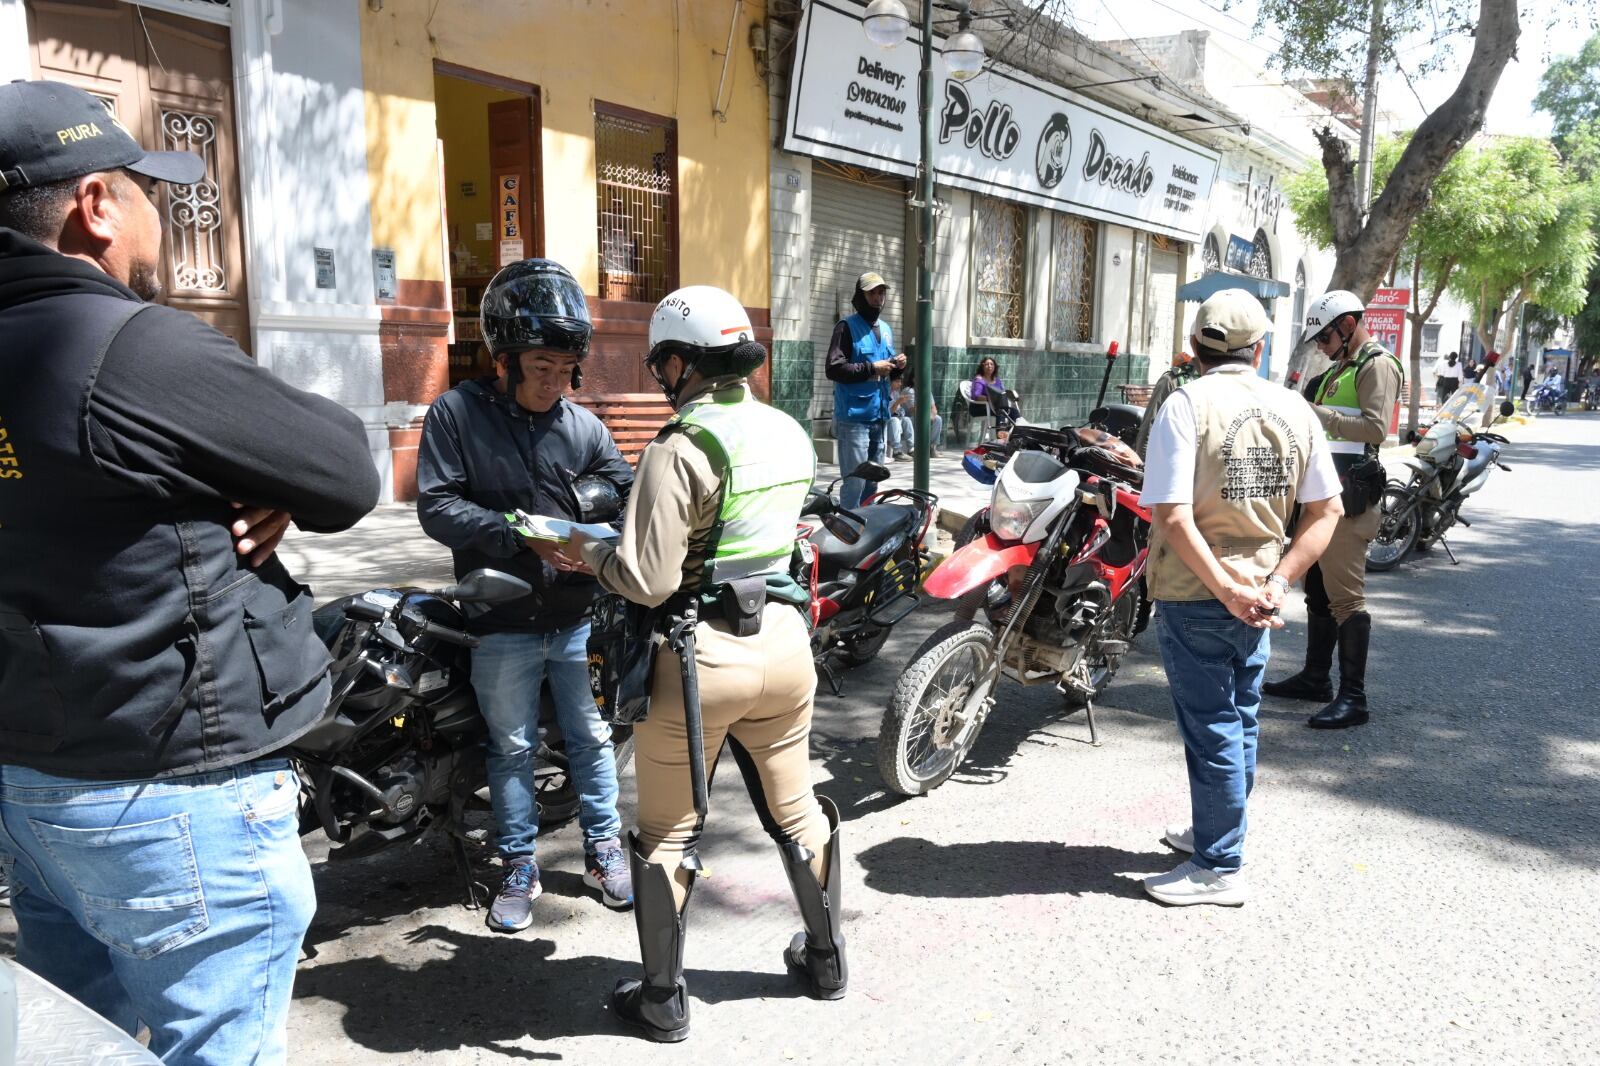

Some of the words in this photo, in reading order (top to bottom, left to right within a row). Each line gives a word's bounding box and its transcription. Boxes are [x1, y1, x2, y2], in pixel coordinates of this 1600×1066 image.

[858, 56, 906, 90] Delivery:
[860, 87, 906, 114] 987421069
[56, 122, 103, 145] PIURA
[939, 79, 1021, 160] Pollo
[1083, 128, 1153, 197] Dorado
[1306, 317, 1321, 326] CIA
[1267, 411, 1297, 456] PROVINCIAL
[1247, 447, 1275, 456] PIURA
